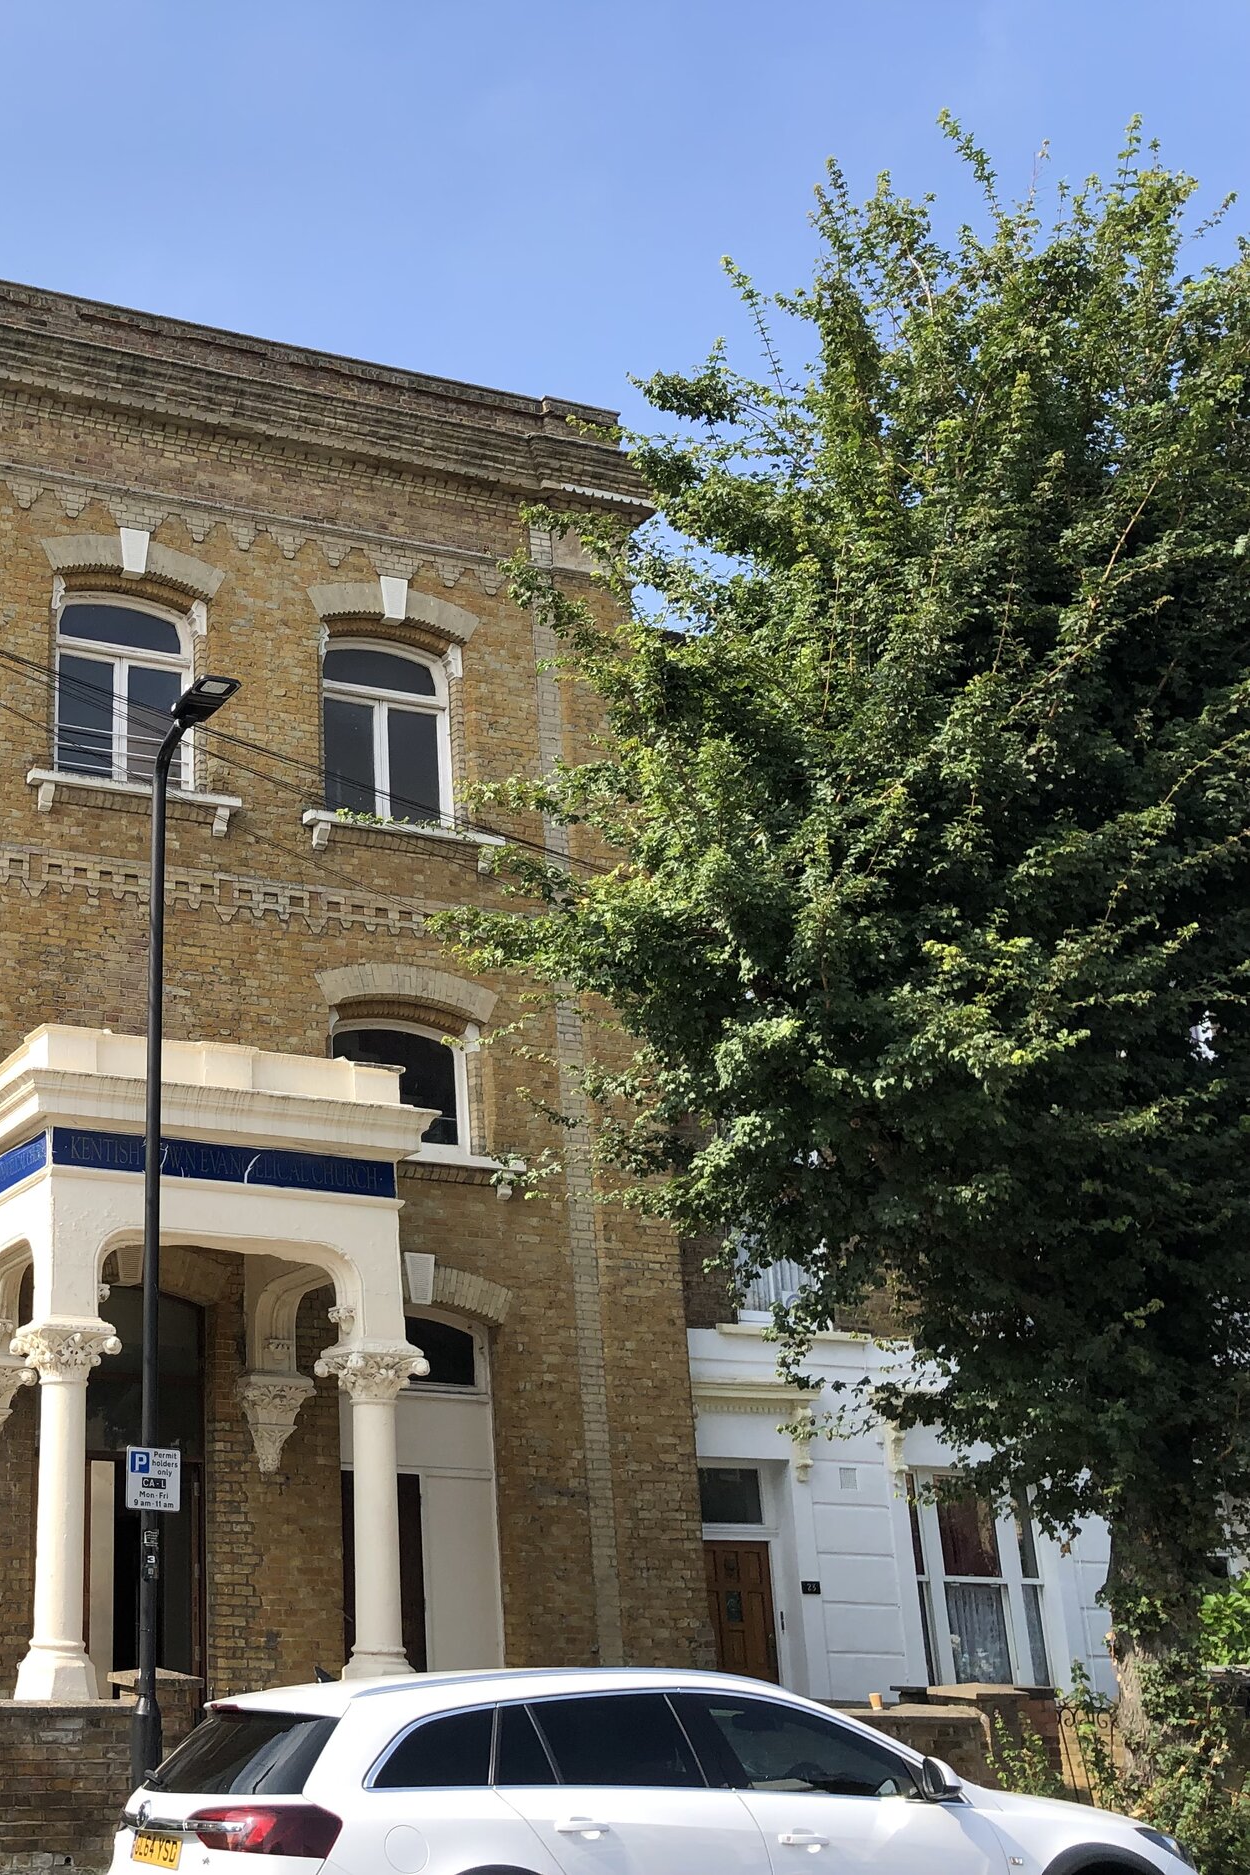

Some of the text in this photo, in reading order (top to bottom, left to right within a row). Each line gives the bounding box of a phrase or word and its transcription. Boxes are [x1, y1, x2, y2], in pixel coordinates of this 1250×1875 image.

[71, 1135, 140, 1165] KENTISH
[150, 1143, 196, 1171] WN
[312, 1163, 377, 1190] CHURCH
[153, 1451, 177, 1460] Permit
[152, 1460, 178, 1468] holders
[157, 1469, 172, 1478] only
[157, 1837, 178, 1863] YSD
